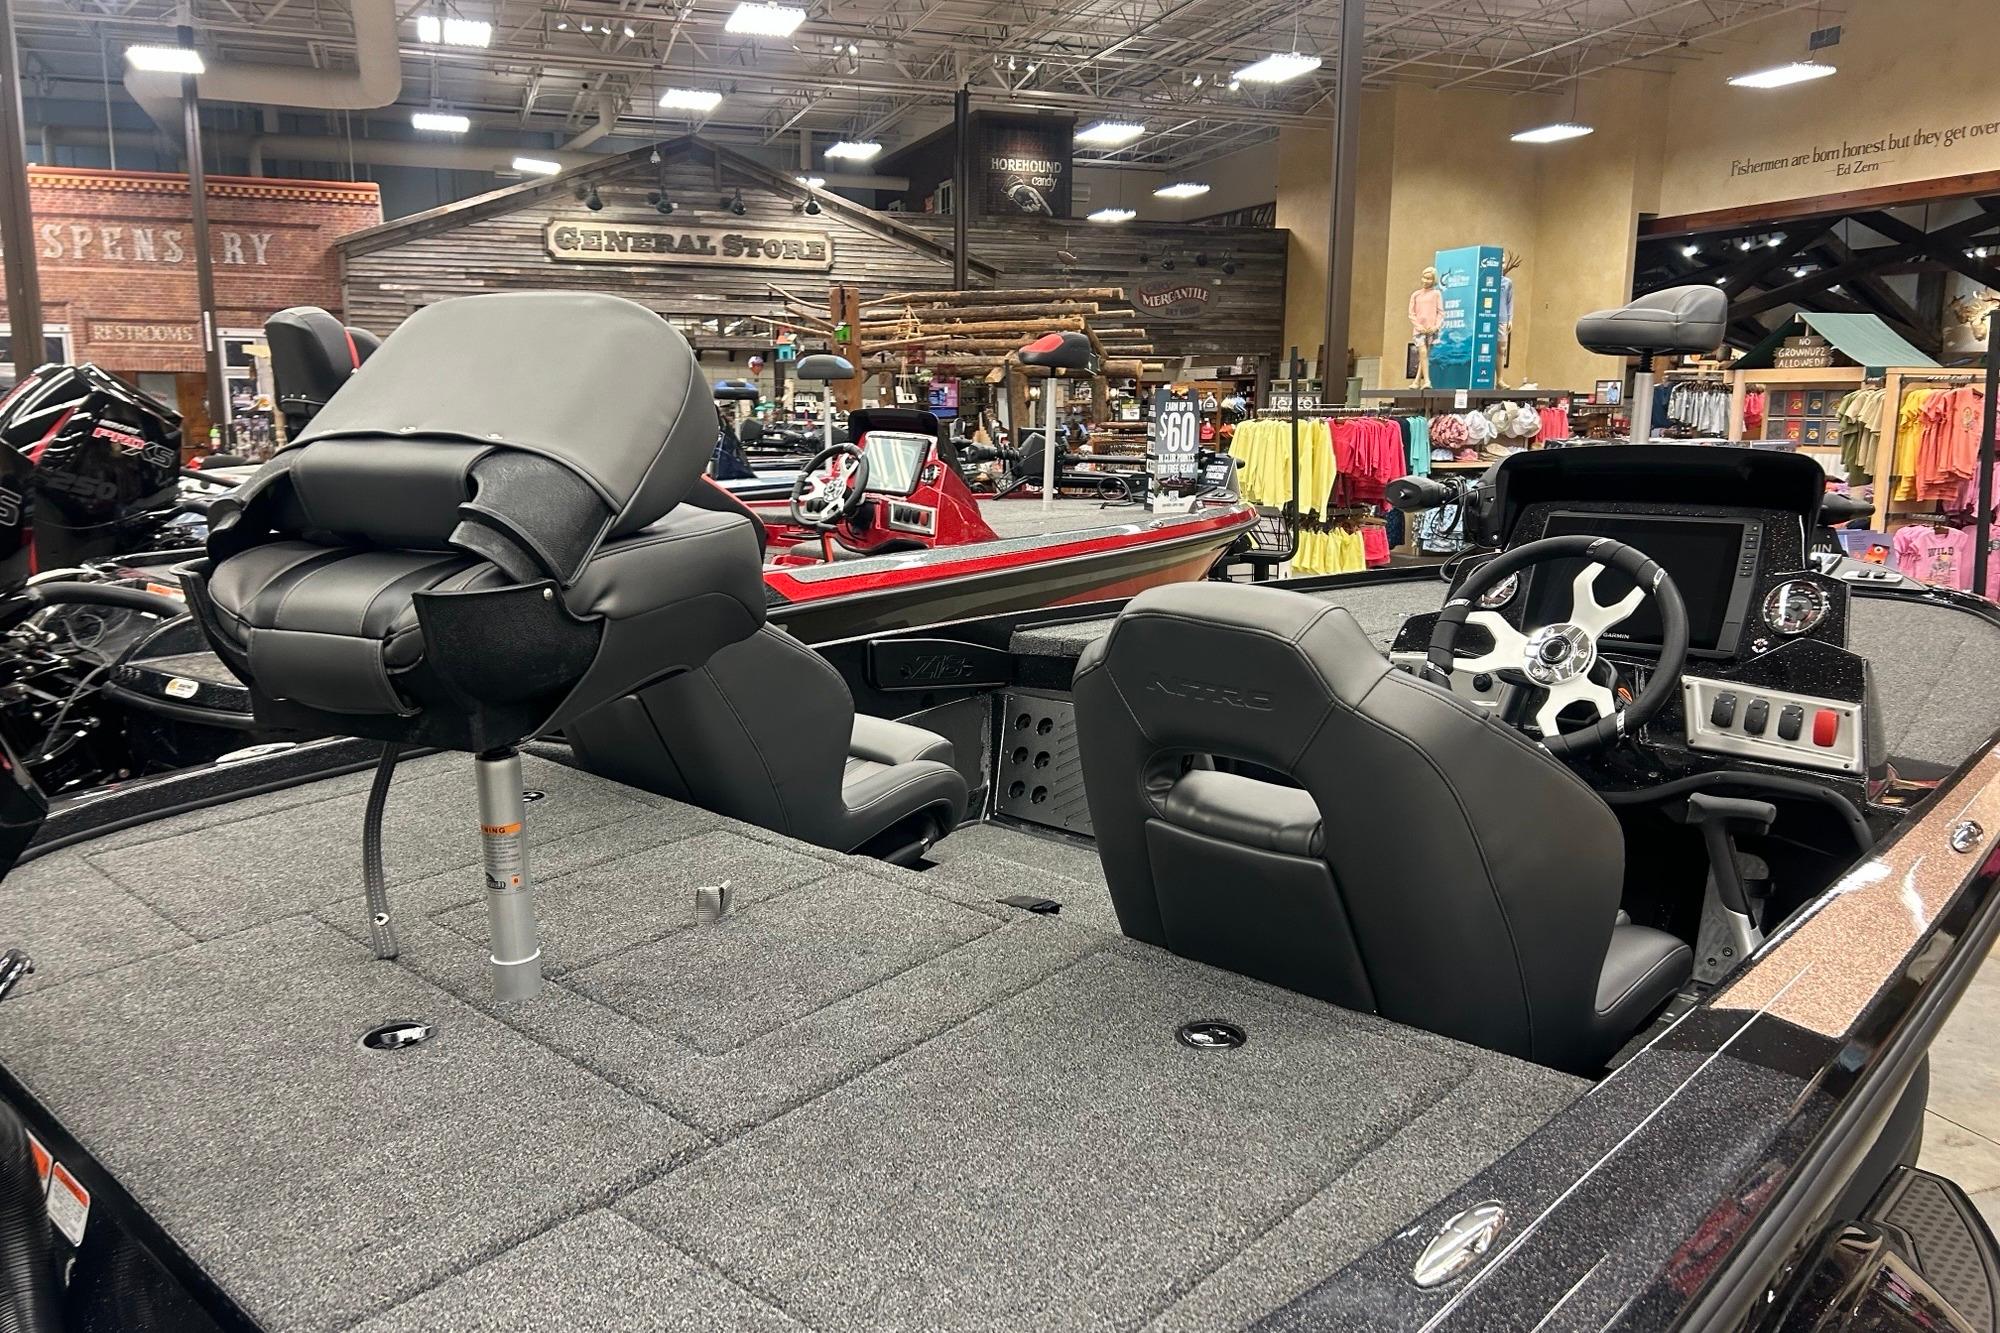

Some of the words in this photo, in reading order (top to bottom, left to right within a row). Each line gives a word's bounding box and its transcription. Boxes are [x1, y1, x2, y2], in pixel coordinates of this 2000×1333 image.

[1731, 158, 1789, 177] Fishermen
[1791, 154, 1811, 167] are
[1812, 146, 1840, 163] born
[1842, 141, 1886, 158] honest
[1888, 133, 1910, 150] but
[1913, 128, 1942, 148] they
[1944, 126, 1967, 147] get
[1969, 121, 2000, 137] over
[991, 157, 1063, 174] HOREHOUND
[1836, 163, 1851, 176] Ed
[1853, 160, 1880, 174] Zern
[1031, 173, 1058, 193] candy
[40, 223, 273, 266] SPENSRY
[554, 226, 717, 256] GENERAL
[722, 234, 826, 261] STORE
[1141, 287, 1209, 307] MERCANTILE
[94, 324, 193, 341] RESTROOMS
[1798, 338, 1811, 346] NO
[1165, 401, 1178, 412] EARN
[1179, 401, 1186, 412] UP
[1187, 401, 1194, 412] TO
[1159, 411, 1196, 453] $60
[1927, 546, 1954, 558] WILD
[1602, 632, 1630, 640] GARMIN
